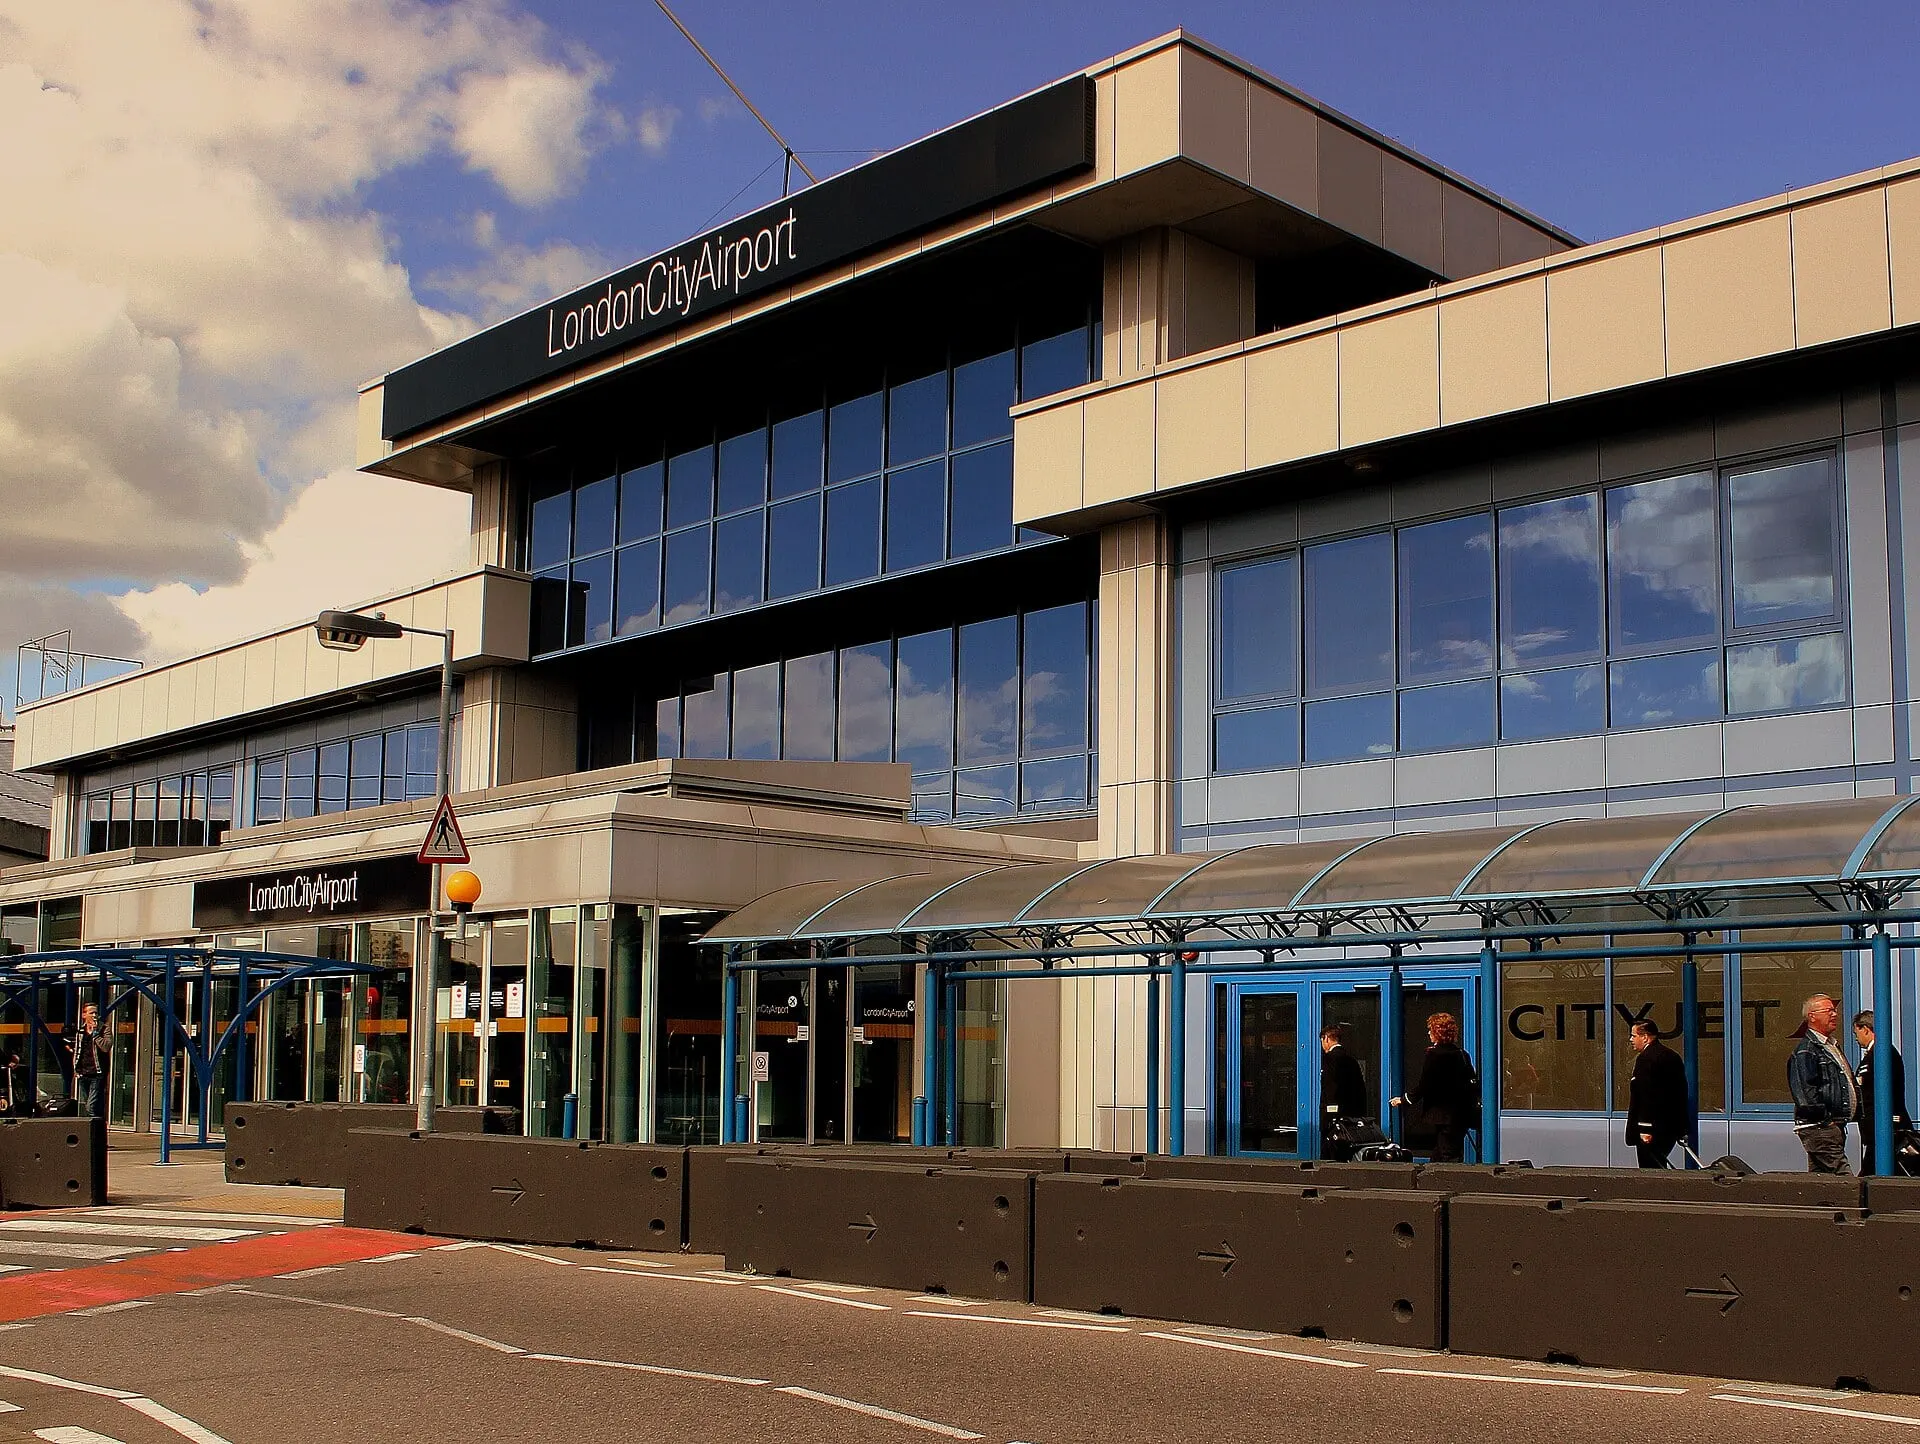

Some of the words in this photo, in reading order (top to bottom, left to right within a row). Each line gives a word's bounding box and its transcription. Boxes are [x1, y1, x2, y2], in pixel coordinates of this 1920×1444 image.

[548, 207, 797, 358] LondonCityAirport
[249, 870, 358, 913] LondonCityAirport
[863, 1007, 909, 1018] LondonCityAirport
